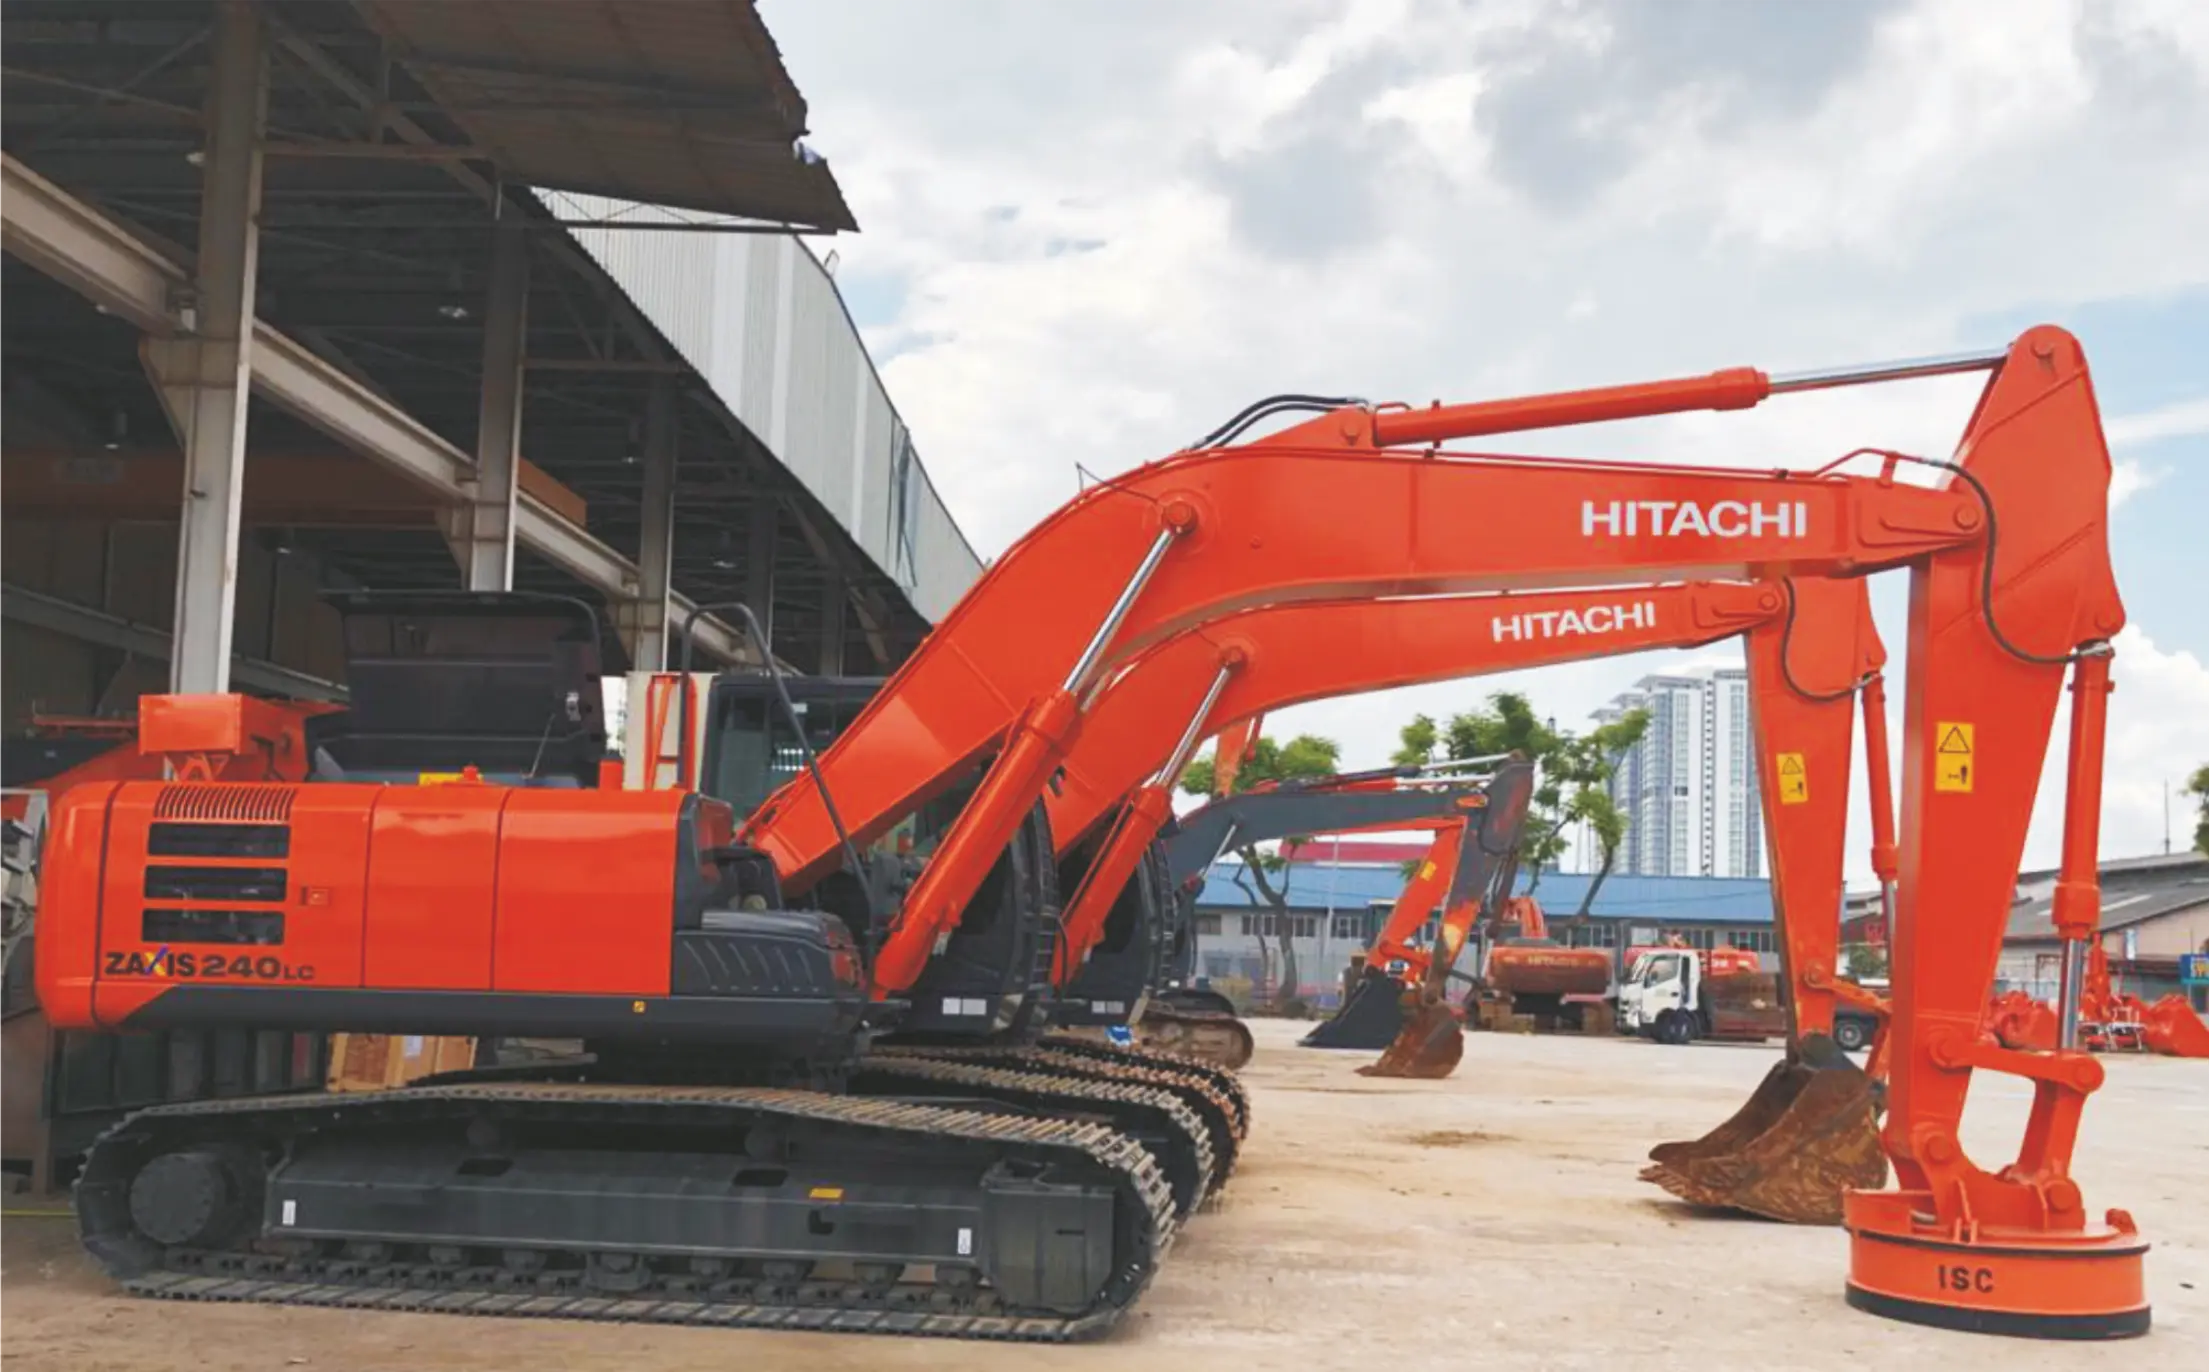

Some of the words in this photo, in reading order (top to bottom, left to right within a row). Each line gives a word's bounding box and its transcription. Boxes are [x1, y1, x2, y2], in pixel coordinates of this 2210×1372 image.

[1582, 500, 1807, 537] HITACHI
[1492, 601, 1656, 642] HITACHI
[105, 945, 195, 976] ZAXIS
[1938, 1264, 1993, 1293] ISC
